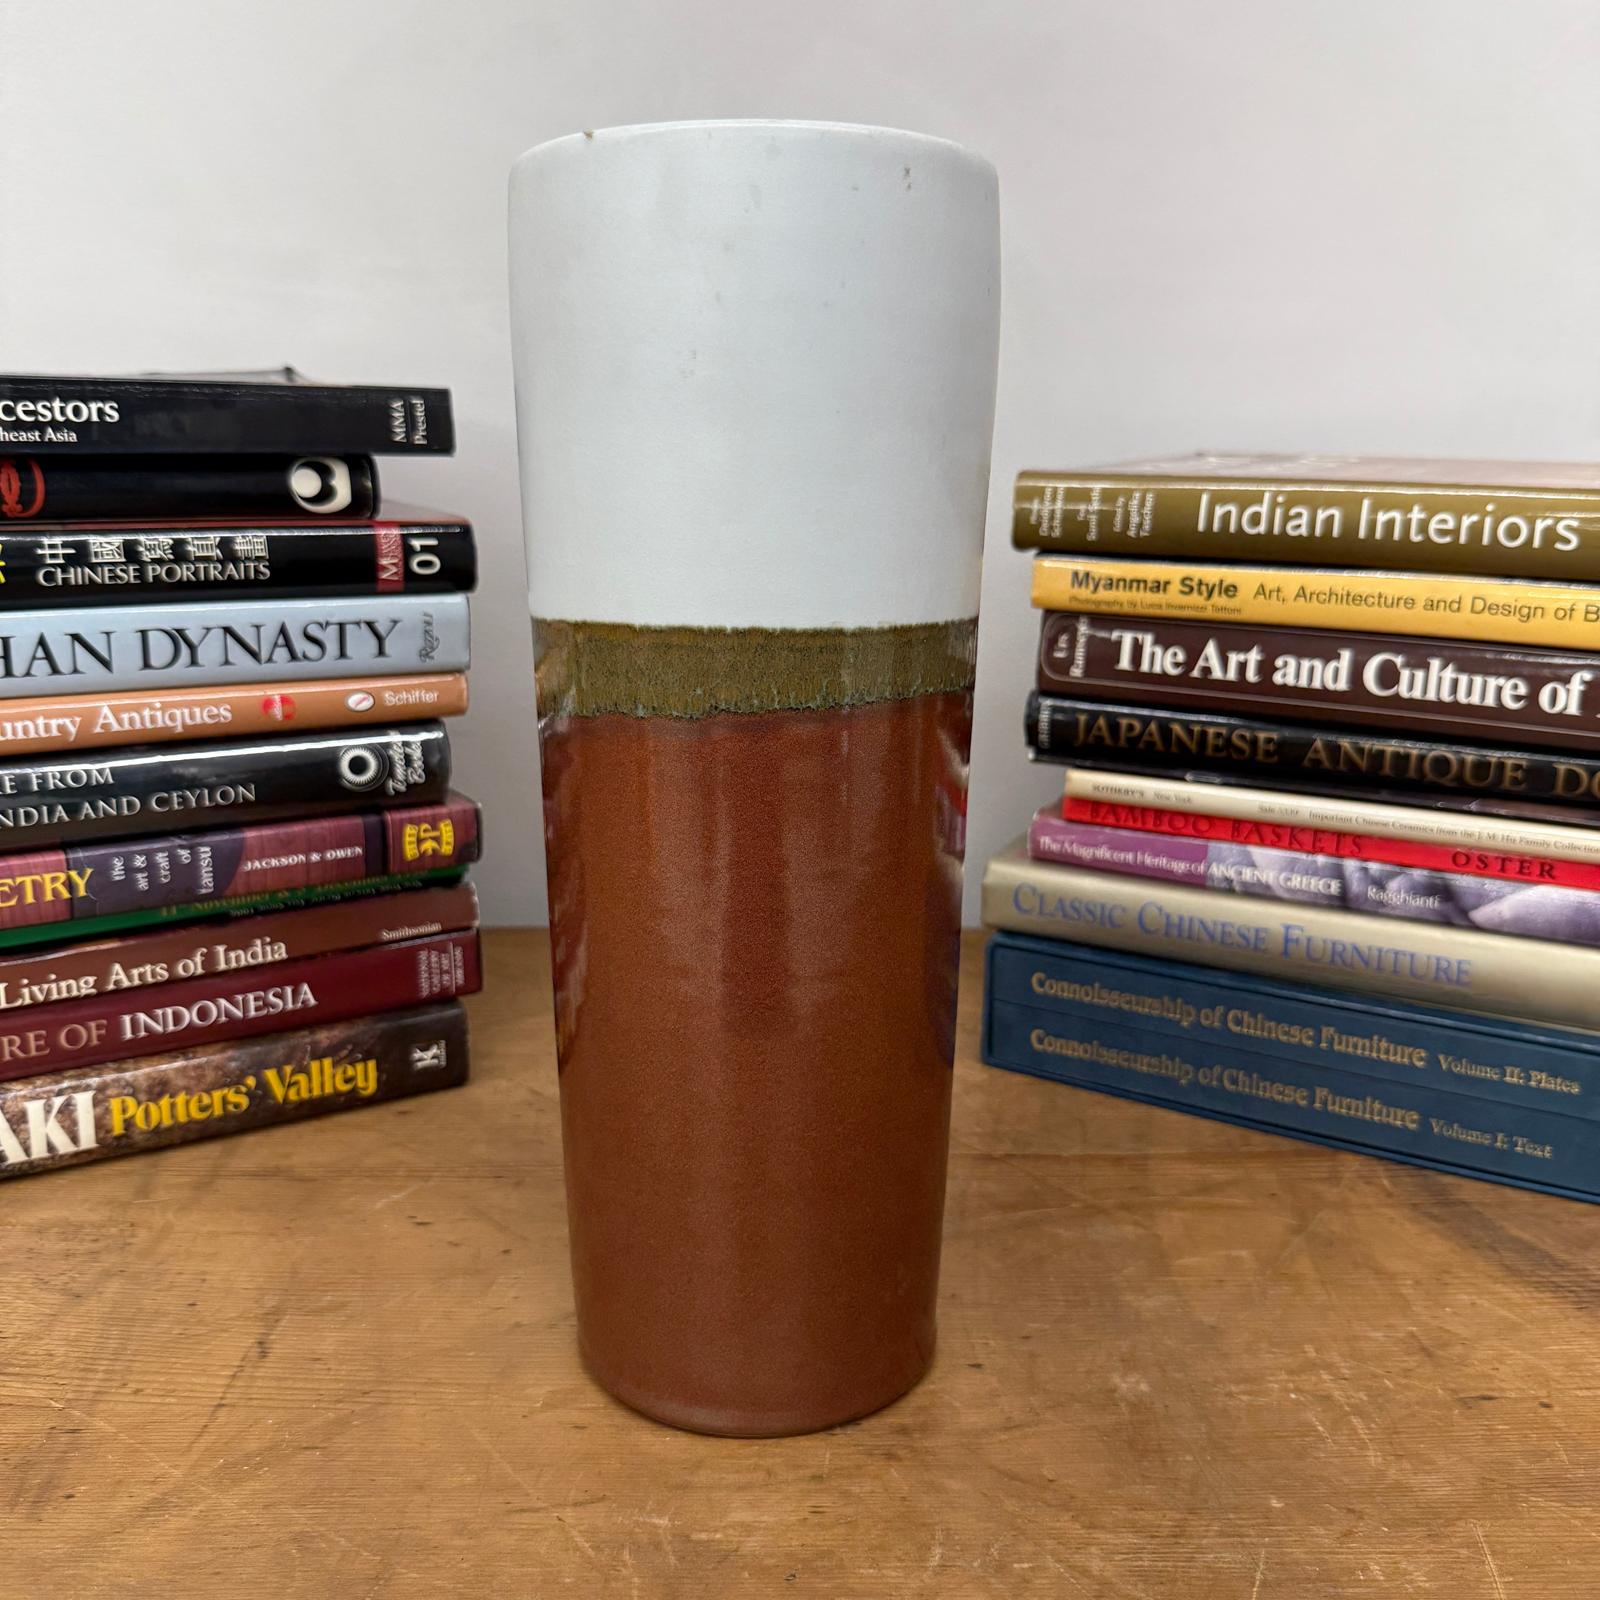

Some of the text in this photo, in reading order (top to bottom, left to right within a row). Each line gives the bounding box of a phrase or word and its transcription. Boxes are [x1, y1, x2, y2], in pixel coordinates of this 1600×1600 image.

[0, 396, 120, 422] cestors
[45, 426, 78, 442] Asia
[1197, 490, 1581, 552] Indian Interiors
[37, 560, 271, 587] CHINESE PORTRAITS
[409, 537, 441, 575] 01
[1070, 571, 1171, 595] Myanmar
[1179, 576, 1239, 601] Style
[1253, 583, 1286, 603] Art,
[1294, 585, 1416, 610] Architecture
[1423, 596, 1461, 614] and
[1470, 597, 1545, 623] Design
[1553, 604, 1576, 621] of
[135, 617, 403, 671] DYNASTY
[384, 688, 440, 706] Schiffer
[1111, 629, 1594, 716] The Art and Culture of
[0, 702, 233, 742] untry Antiques
[30, 767, 115, 792] FROM
[1074, 712, 1600, 799] JAPANESE ANTIQUE D
[79, 795, 141, 821] AND
[150, 782, 256, 813] CEYLON
[243, 846, 364, 872] JACKSON & OWEN
[1089, 800, 1557, 880] BAMBOO BASKETS OSTER
[0, 868, 94, 908] ETRY
[1040, 836, 1062, 854] The
[1063, 840, 1135, 865] Magnificent
[1137, 851, 1190, 875] Heritage
[1192, 861, 1206, 875] of
[1208, 861, 1277, 885] ANCIENT
[1280, 873, 1343, 897] GREECE
[381, 922, 442, 941] Smithsonian
[0, 936, 288, 1009] Living Arts of India
[1, 982, 318, 1061] RE OF INDONESIA
[1030, 971, 1196, 1028] Connoisseurship
[1200, 1004, 1224, 1028] of
[1227, 1008, 1314, 1046] Chinese
[1320, 1025, 1428, 1069] Furniture
[1438, 1053, 1501, 1082] Volume
[1529, 1070, 1581, 1095] Plates
[109, 1075, 257, 1137] Potters'
[263, 1056, 378, 1105] Valley
[1030, 1028, 1194, 1086] Connoisseurship
[1198, 1064, 1222, 1085] of
[1223, 1068, 1308, 1105] Chinese
[1313, 1087, 1420, 1131] Furniture
[1429, 1117, 1491, 1148] Volume
[1513, 1135, 1553, 1160] Text
